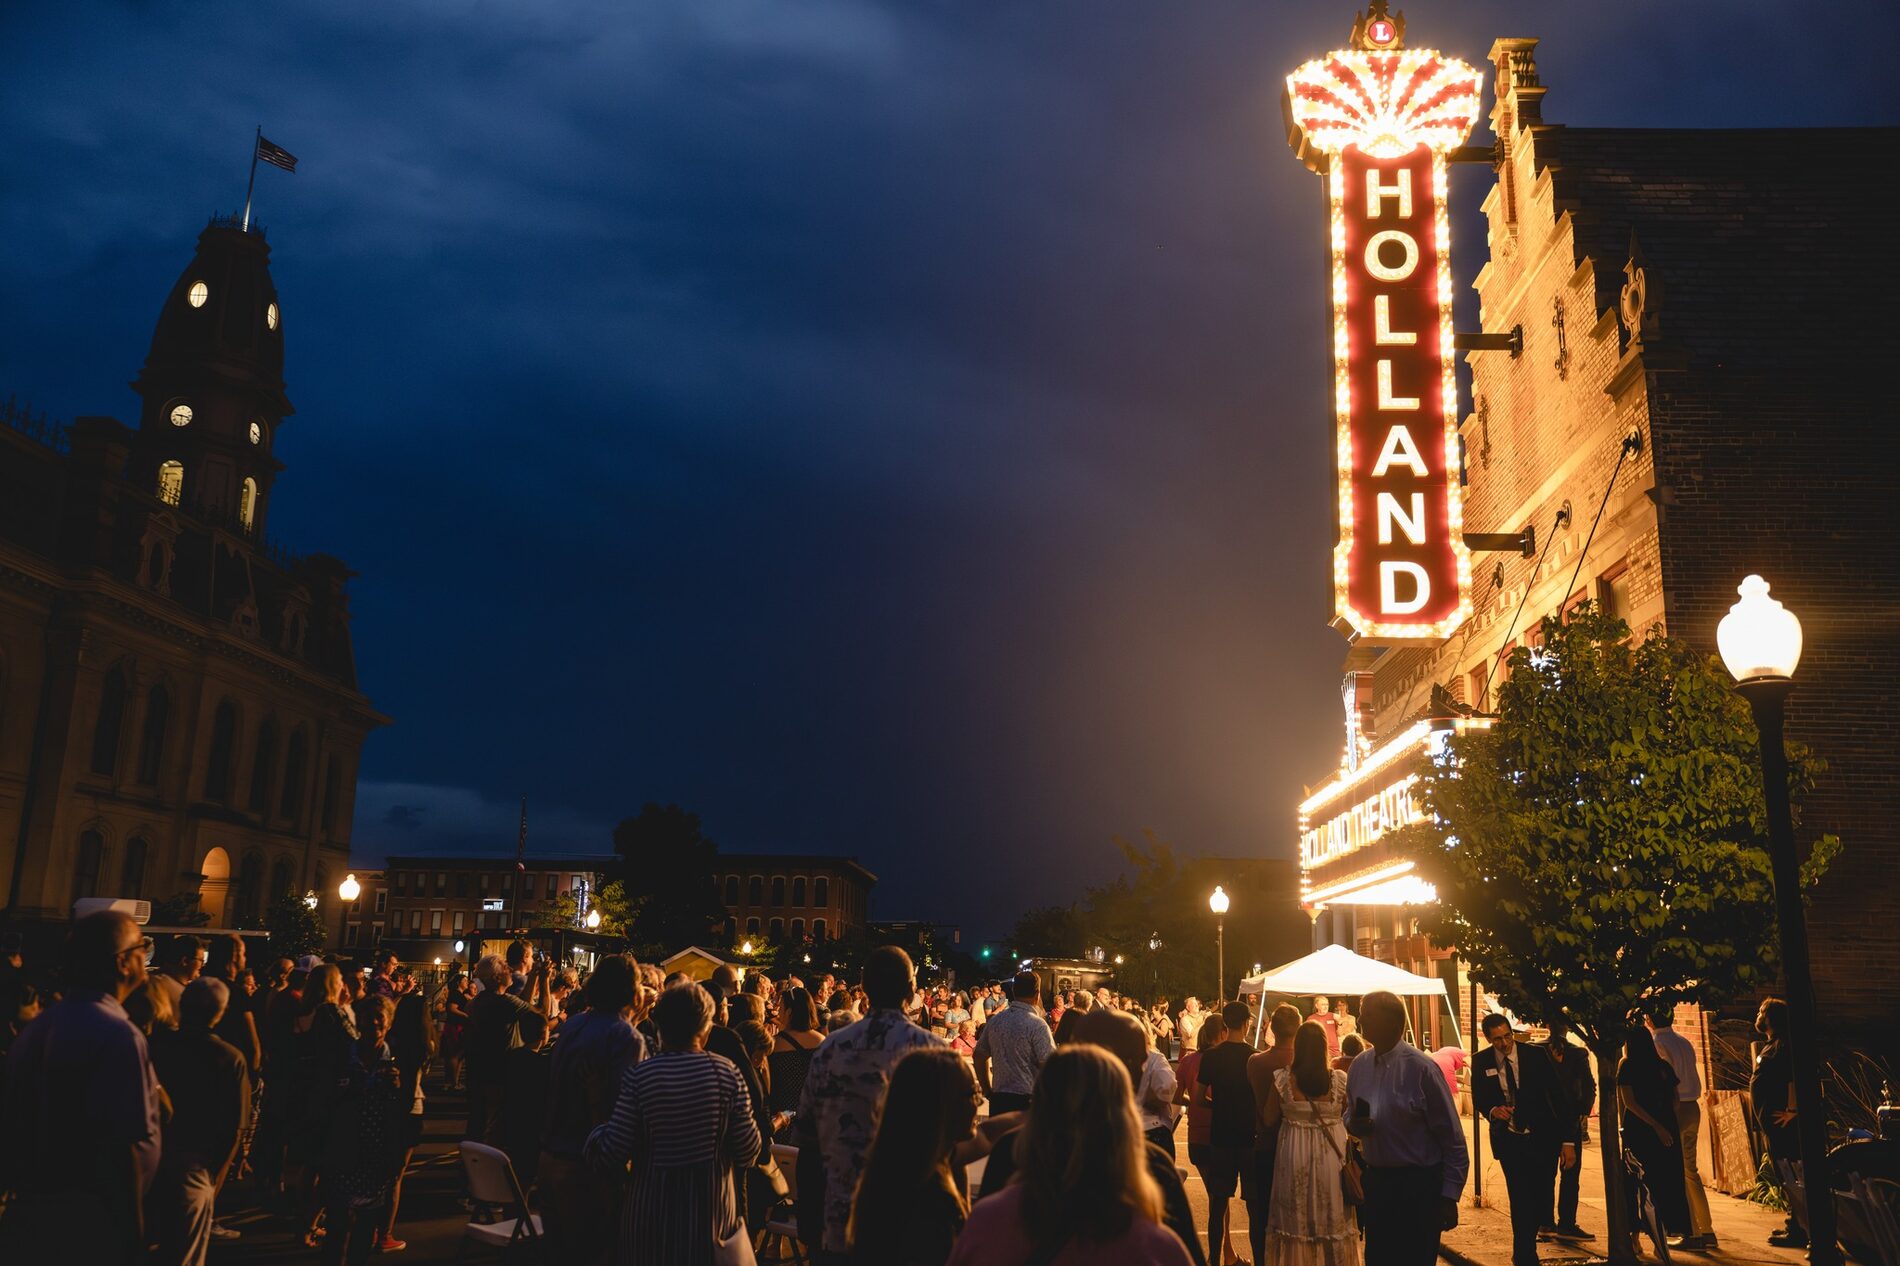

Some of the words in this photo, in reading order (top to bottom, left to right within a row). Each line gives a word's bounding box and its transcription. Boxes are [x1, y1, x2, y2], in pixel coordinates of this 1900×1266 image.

[1375, 23, 1390, 41] L
[1364, 168, 1431, 615] HOLLAND
[1301, 811, 1351, 869] HOLLAND
[1351, 772, 1422, 847] THEATRE
